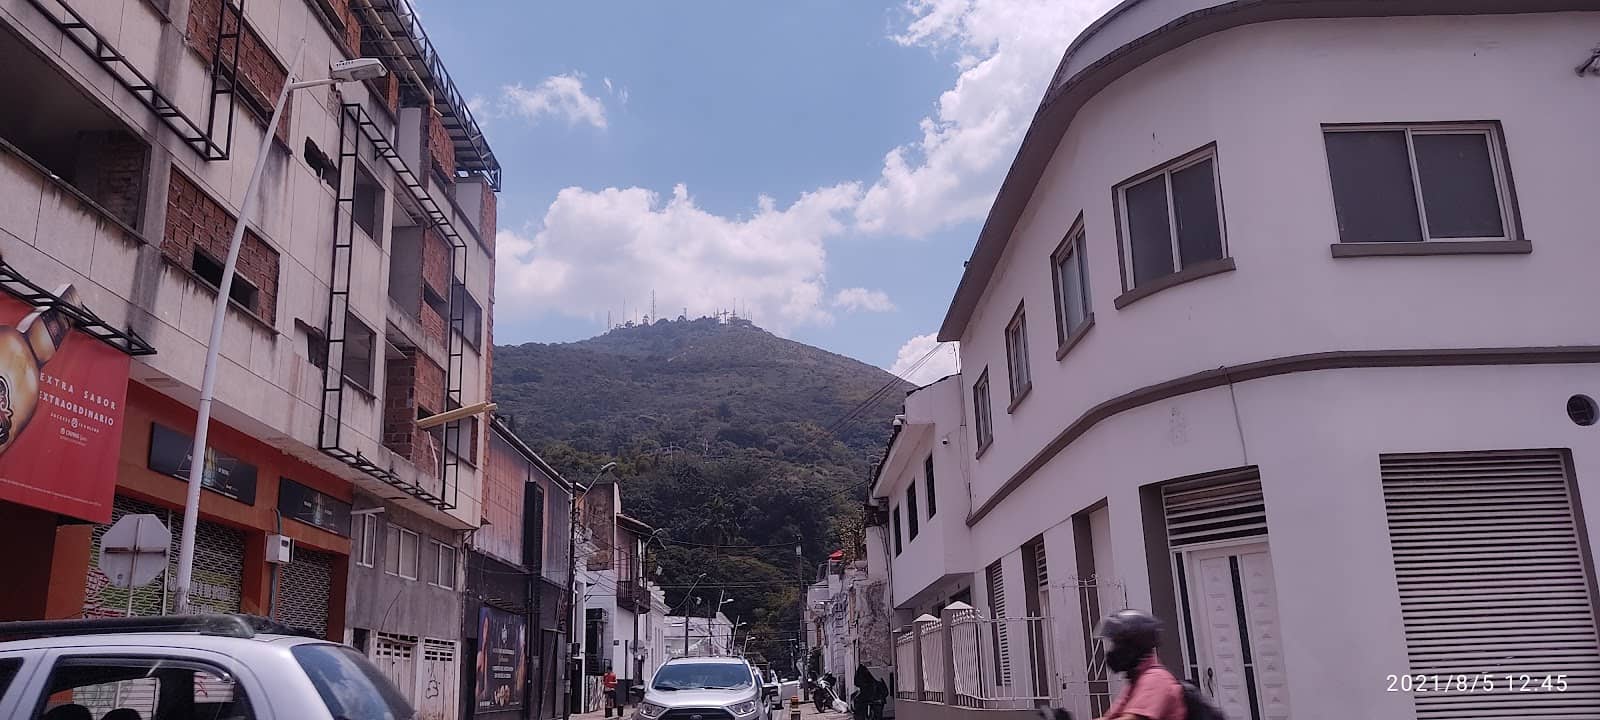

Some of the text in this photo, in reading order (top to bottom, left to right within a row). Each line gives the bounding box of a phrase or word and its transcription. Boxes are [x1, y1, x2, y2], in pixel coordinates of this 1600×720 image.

[39, 390, 114, 426] EXTRAORDINARIO
[40, 372, 115, 410] EXTRA SABOR
